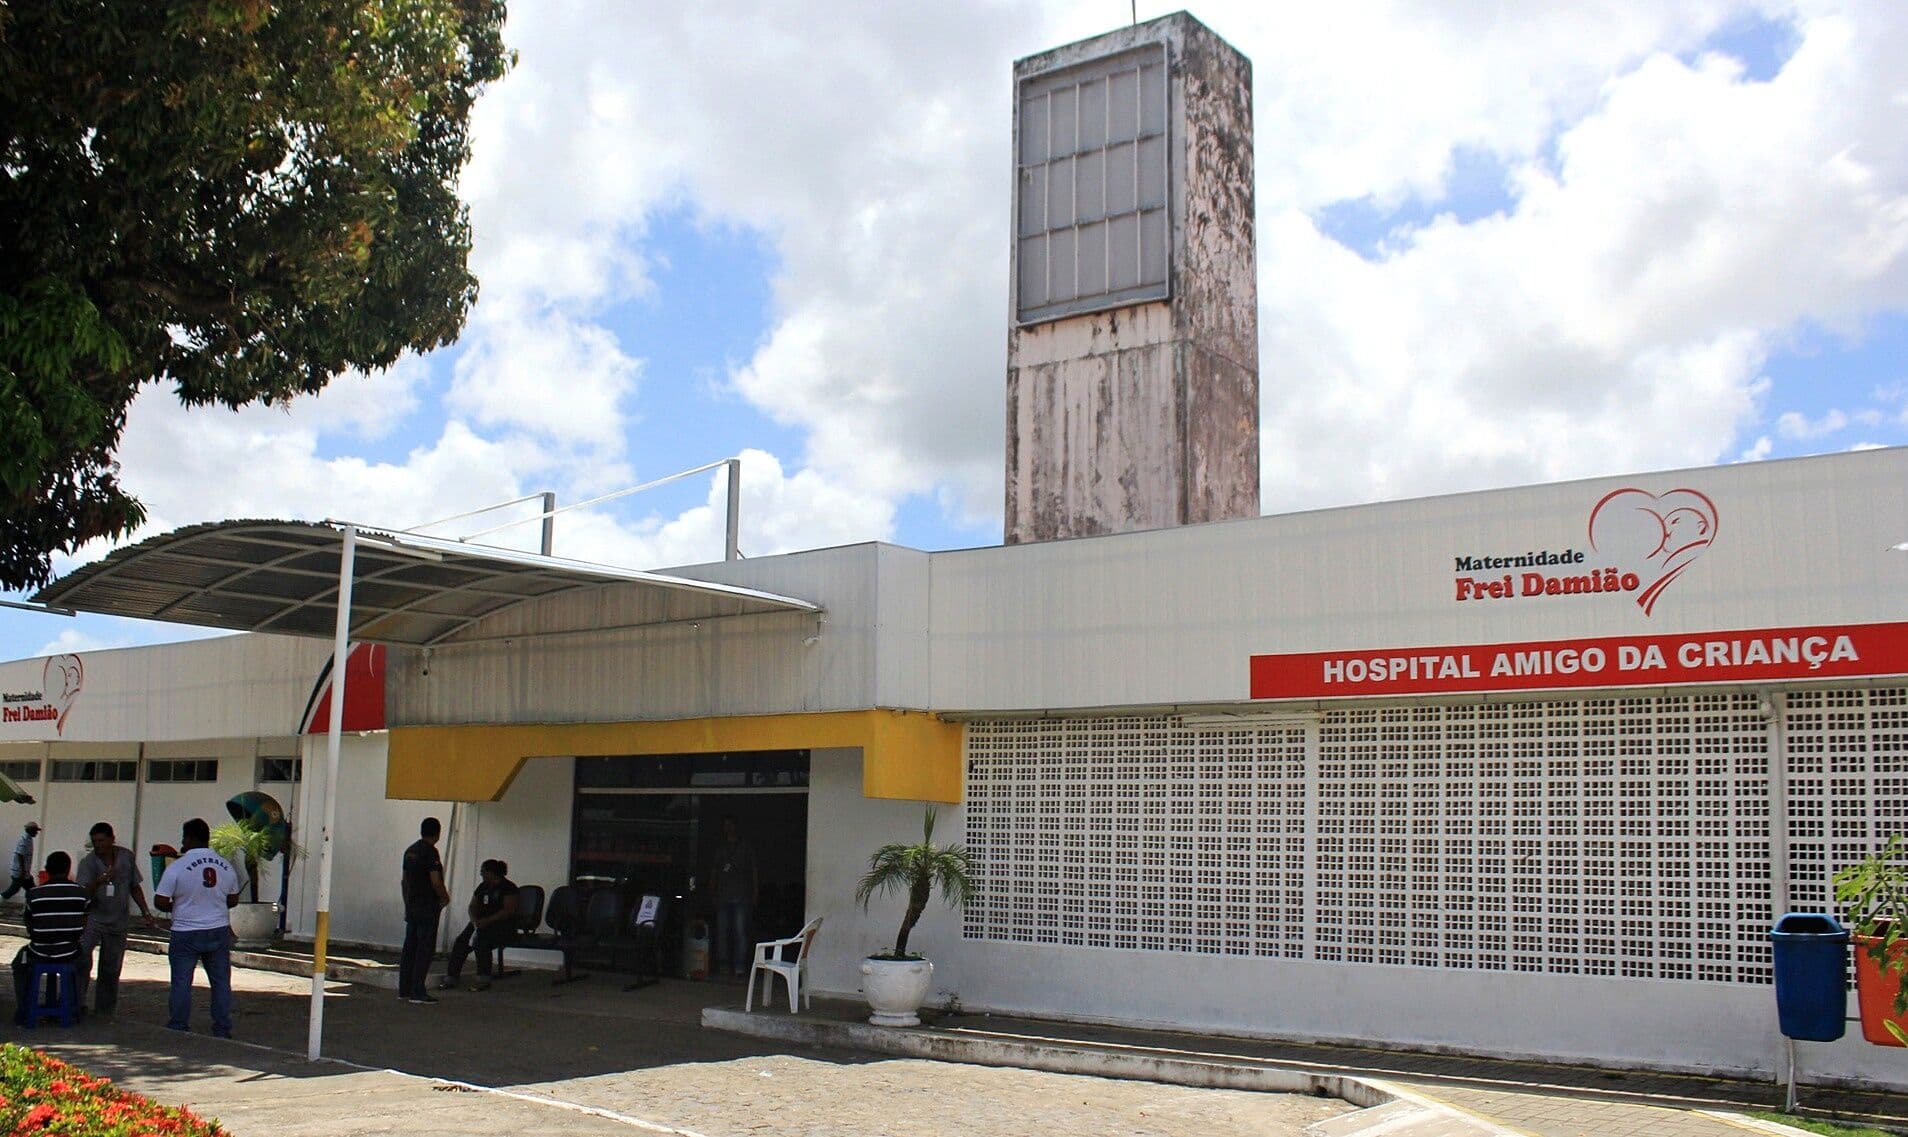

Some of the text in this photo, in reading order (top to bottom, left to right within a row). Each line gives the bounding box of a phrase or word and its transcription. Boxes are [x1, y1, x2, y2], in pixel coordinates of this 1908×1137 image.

[1455, 550, 1584, 572] Maternidade
[1455, 567, 1640, 601] Frei Damião
[1323, 635, 1859, 684] HOSPITAL AMIGO DA CRIANÇA
[3, 704, 58, 722] Frei Damião
[203, 867, 217, 888] 9
